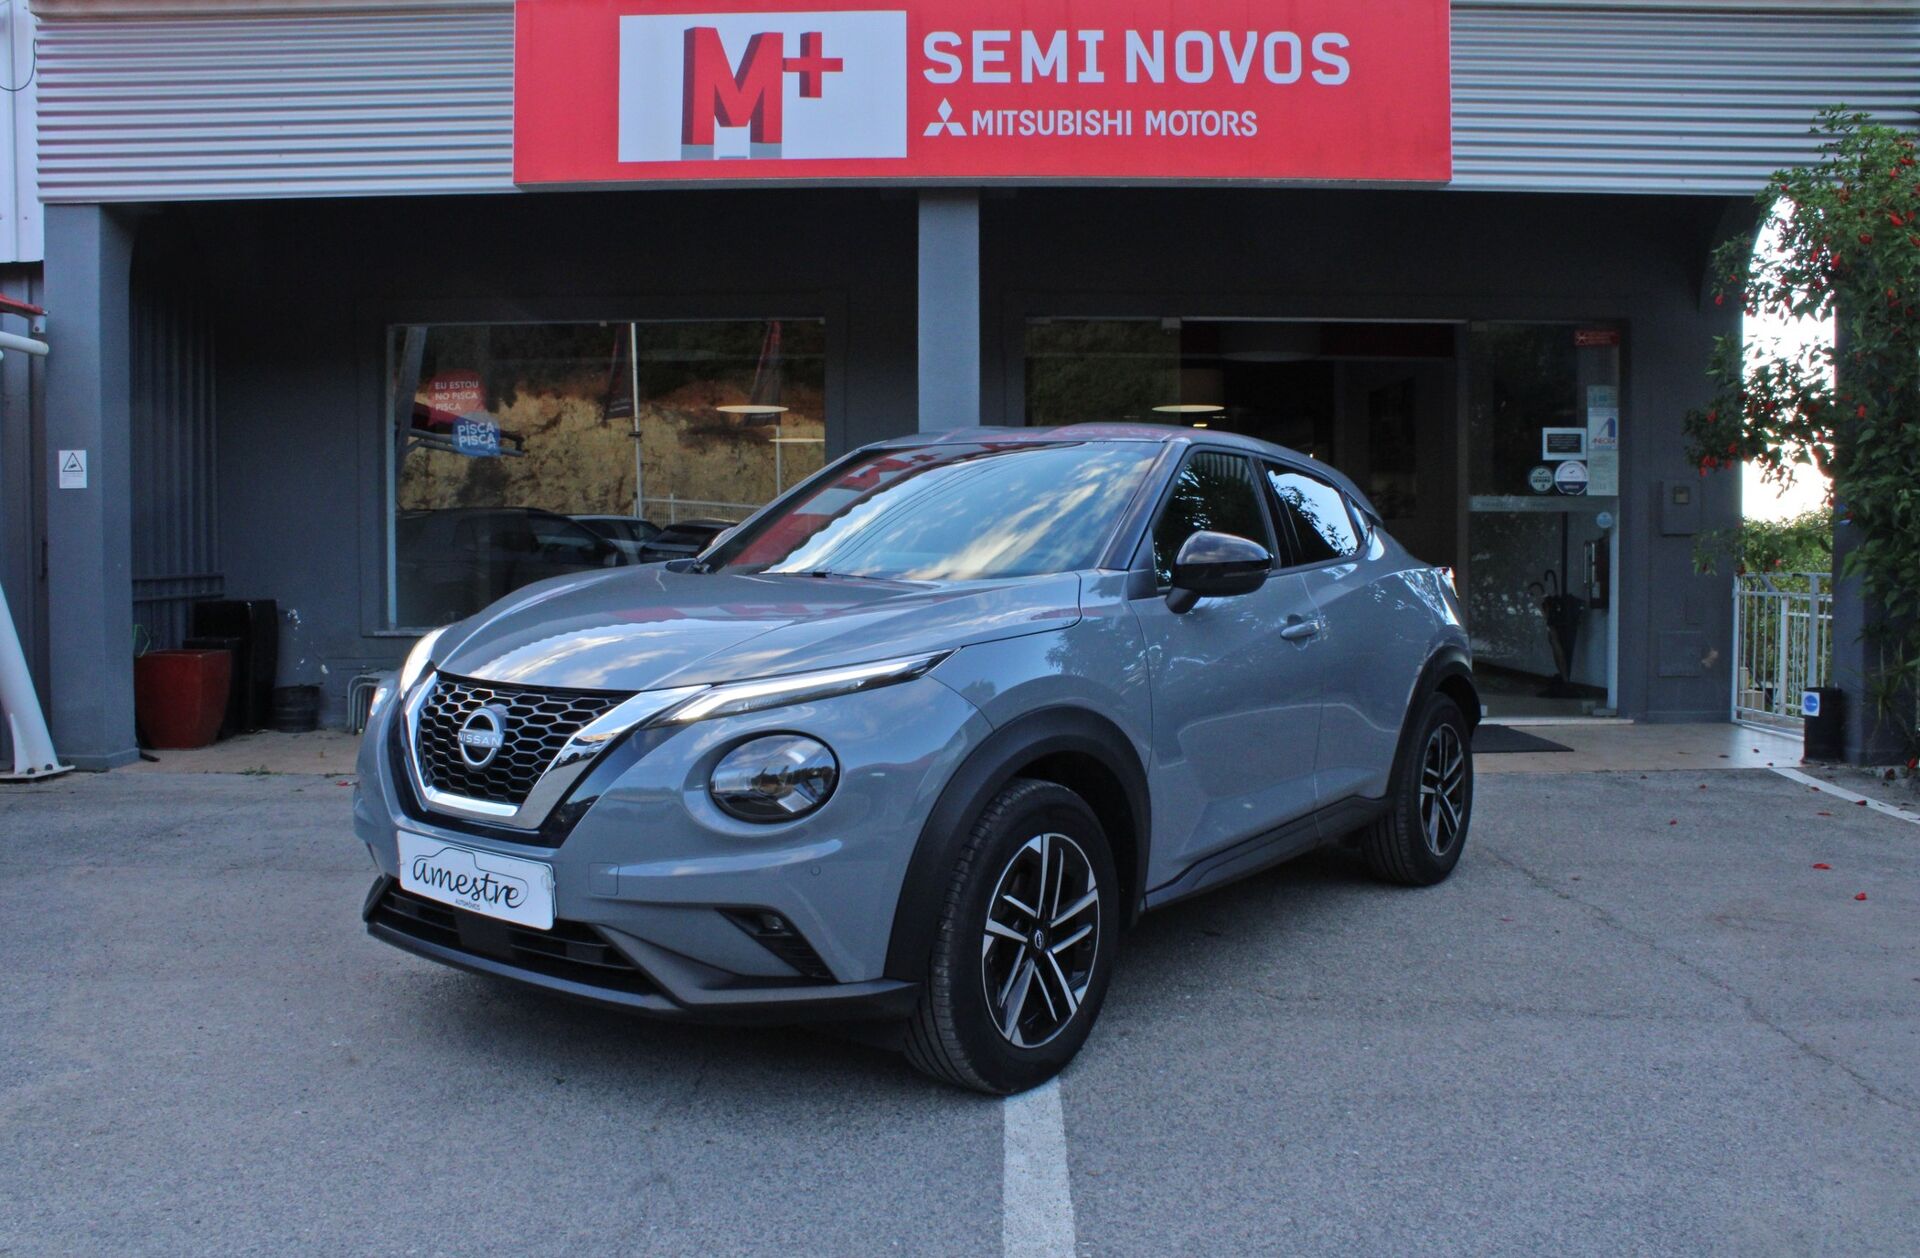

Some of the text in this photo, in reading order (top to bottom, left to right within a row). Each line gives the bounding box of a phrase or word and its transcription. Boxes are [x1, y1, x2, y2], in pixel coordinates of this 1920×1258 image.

[922, 29, 1350, 86] SEMI NOVOS
[972, 109, 1258, 136] MITSUBISHI MOTORS
[434, 381, 479, 390] EU ESTOU
[435, 392, 478, 401] NO PISCA
[435, 403, 461, 411] PISCA
[459, 731, 501, 747] NISSAN
[412, 857, 520, 908] amestre
